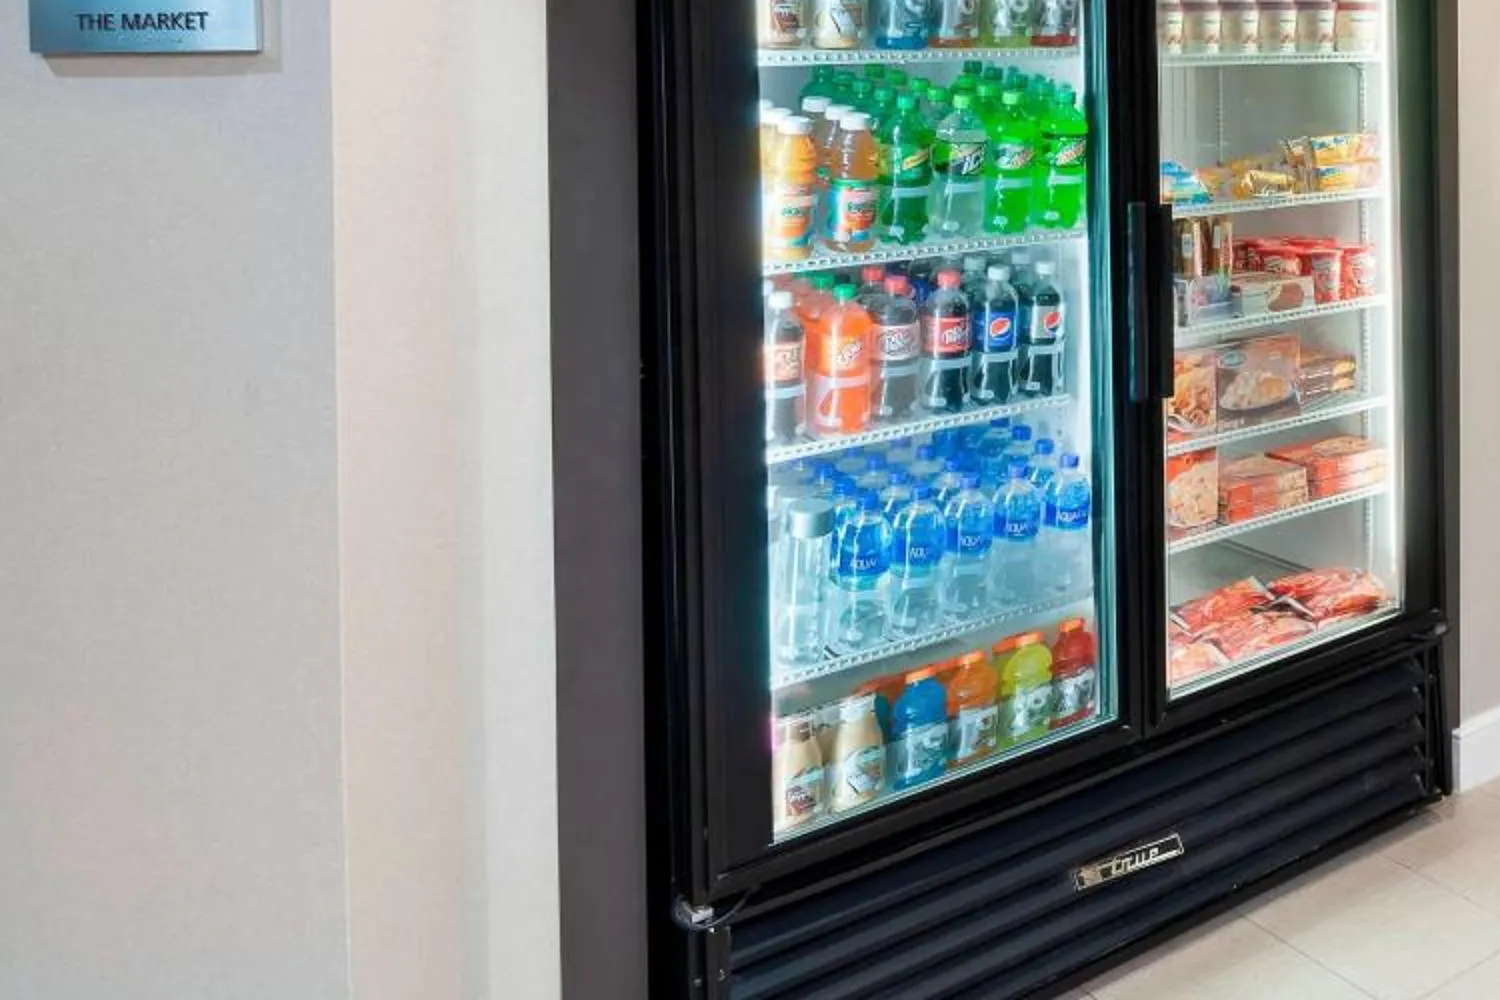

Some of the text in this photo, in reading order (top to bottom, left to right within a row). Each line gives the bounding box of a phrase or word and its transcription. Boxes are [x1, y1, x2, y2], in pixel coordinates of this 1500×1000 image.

[77, 11, 209, 31] THE MARKET
[1111, 847, 1161, 876] true
